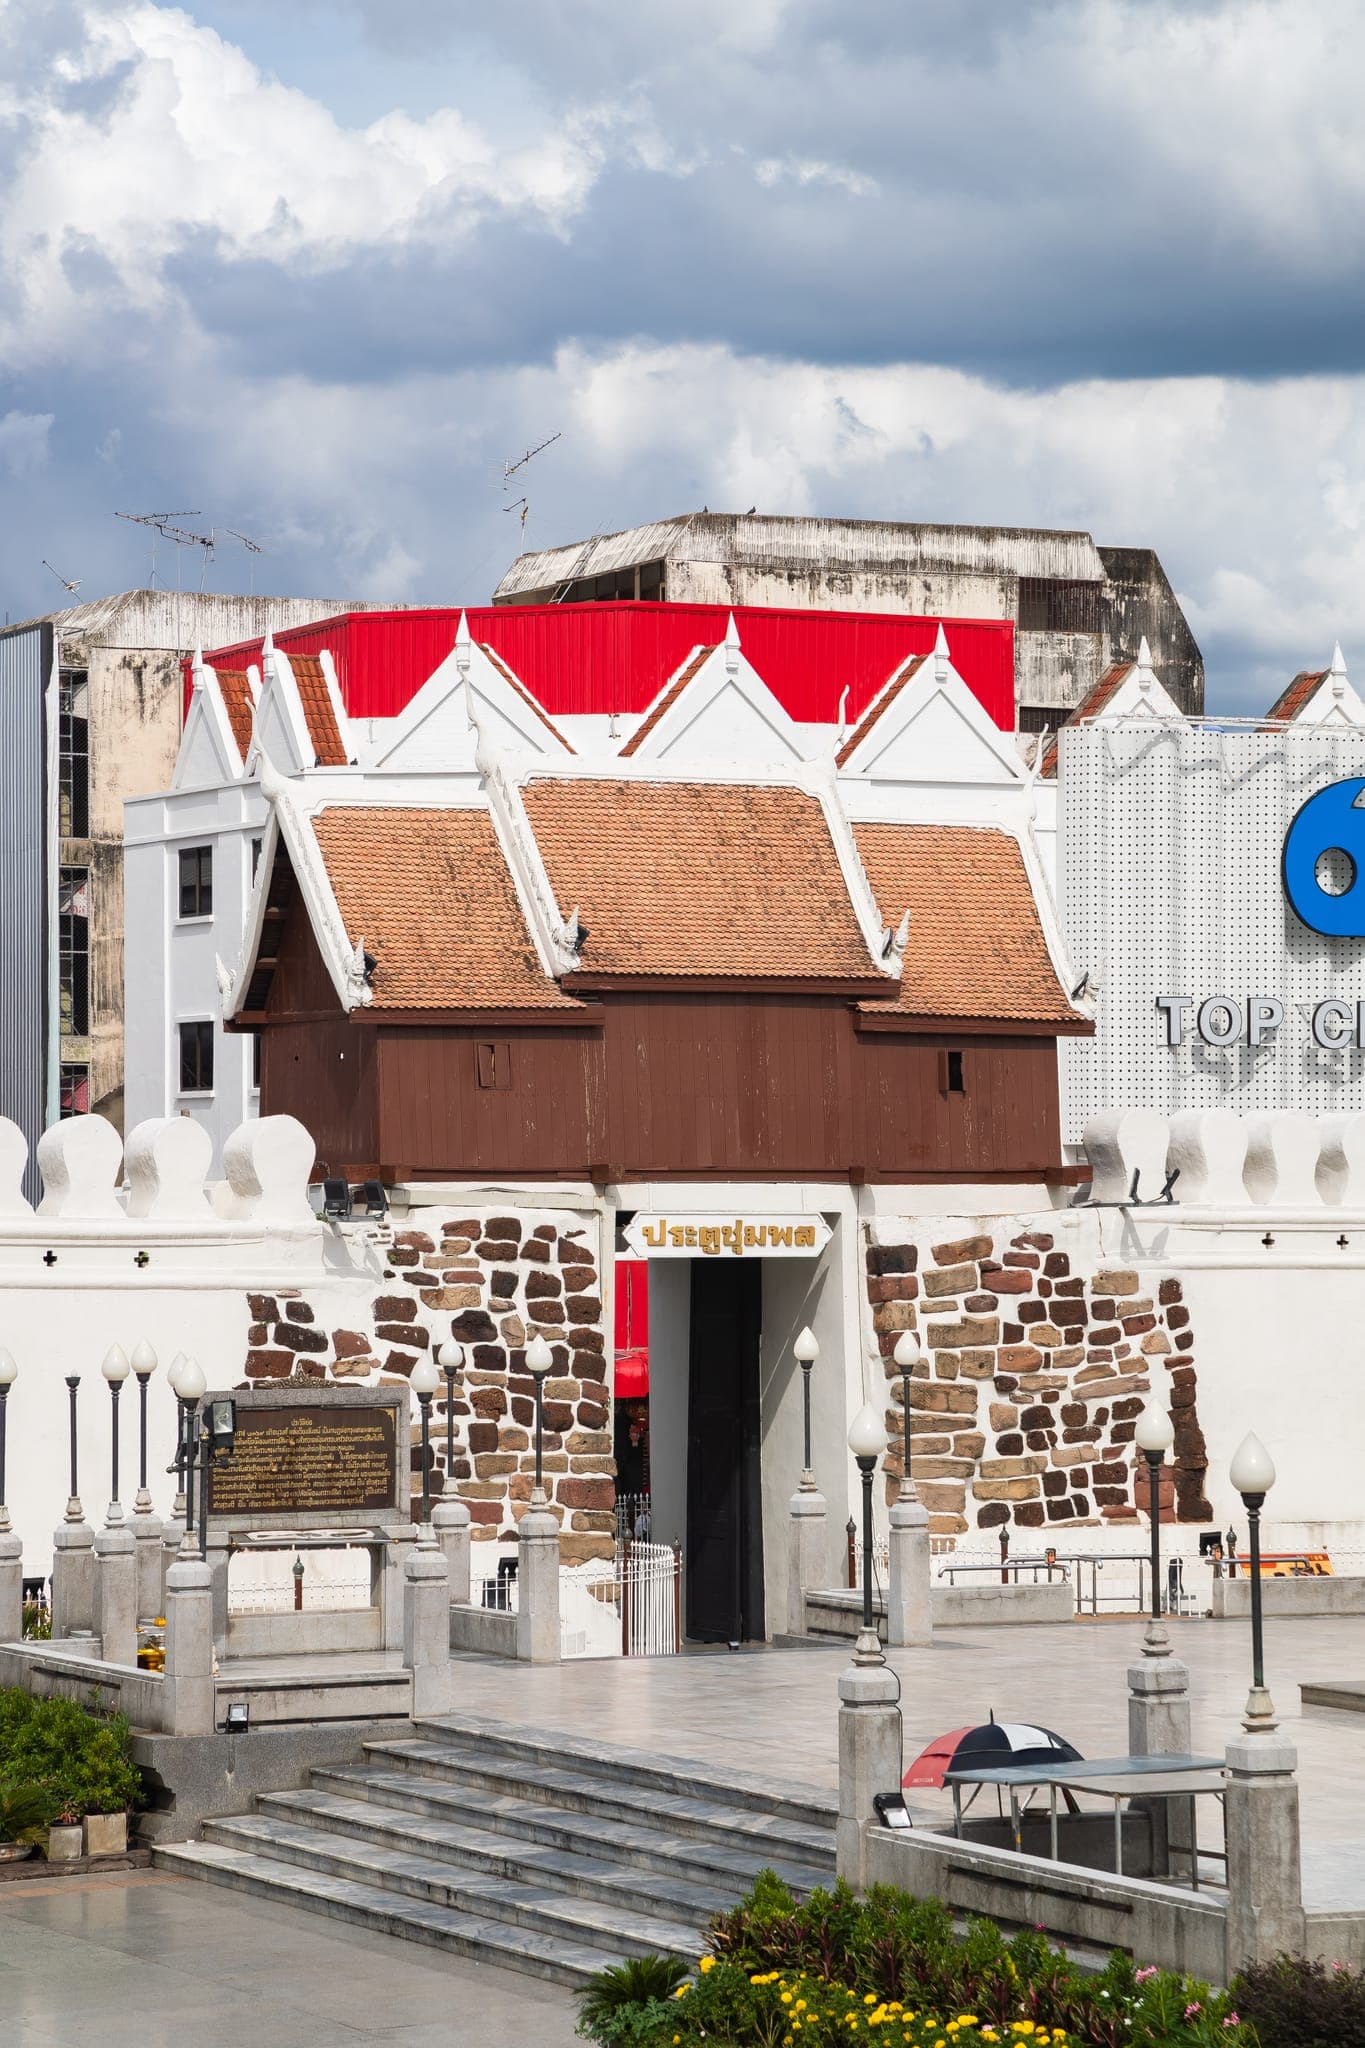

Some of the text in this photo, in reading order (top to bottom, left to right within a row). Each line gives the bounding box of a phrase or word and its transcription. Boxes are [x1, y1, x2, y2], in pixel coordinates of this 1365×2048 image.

[1156, 996, 1365, 1050] TOP C
[642, 1219, 816, 1255] ประตูชุมพล
